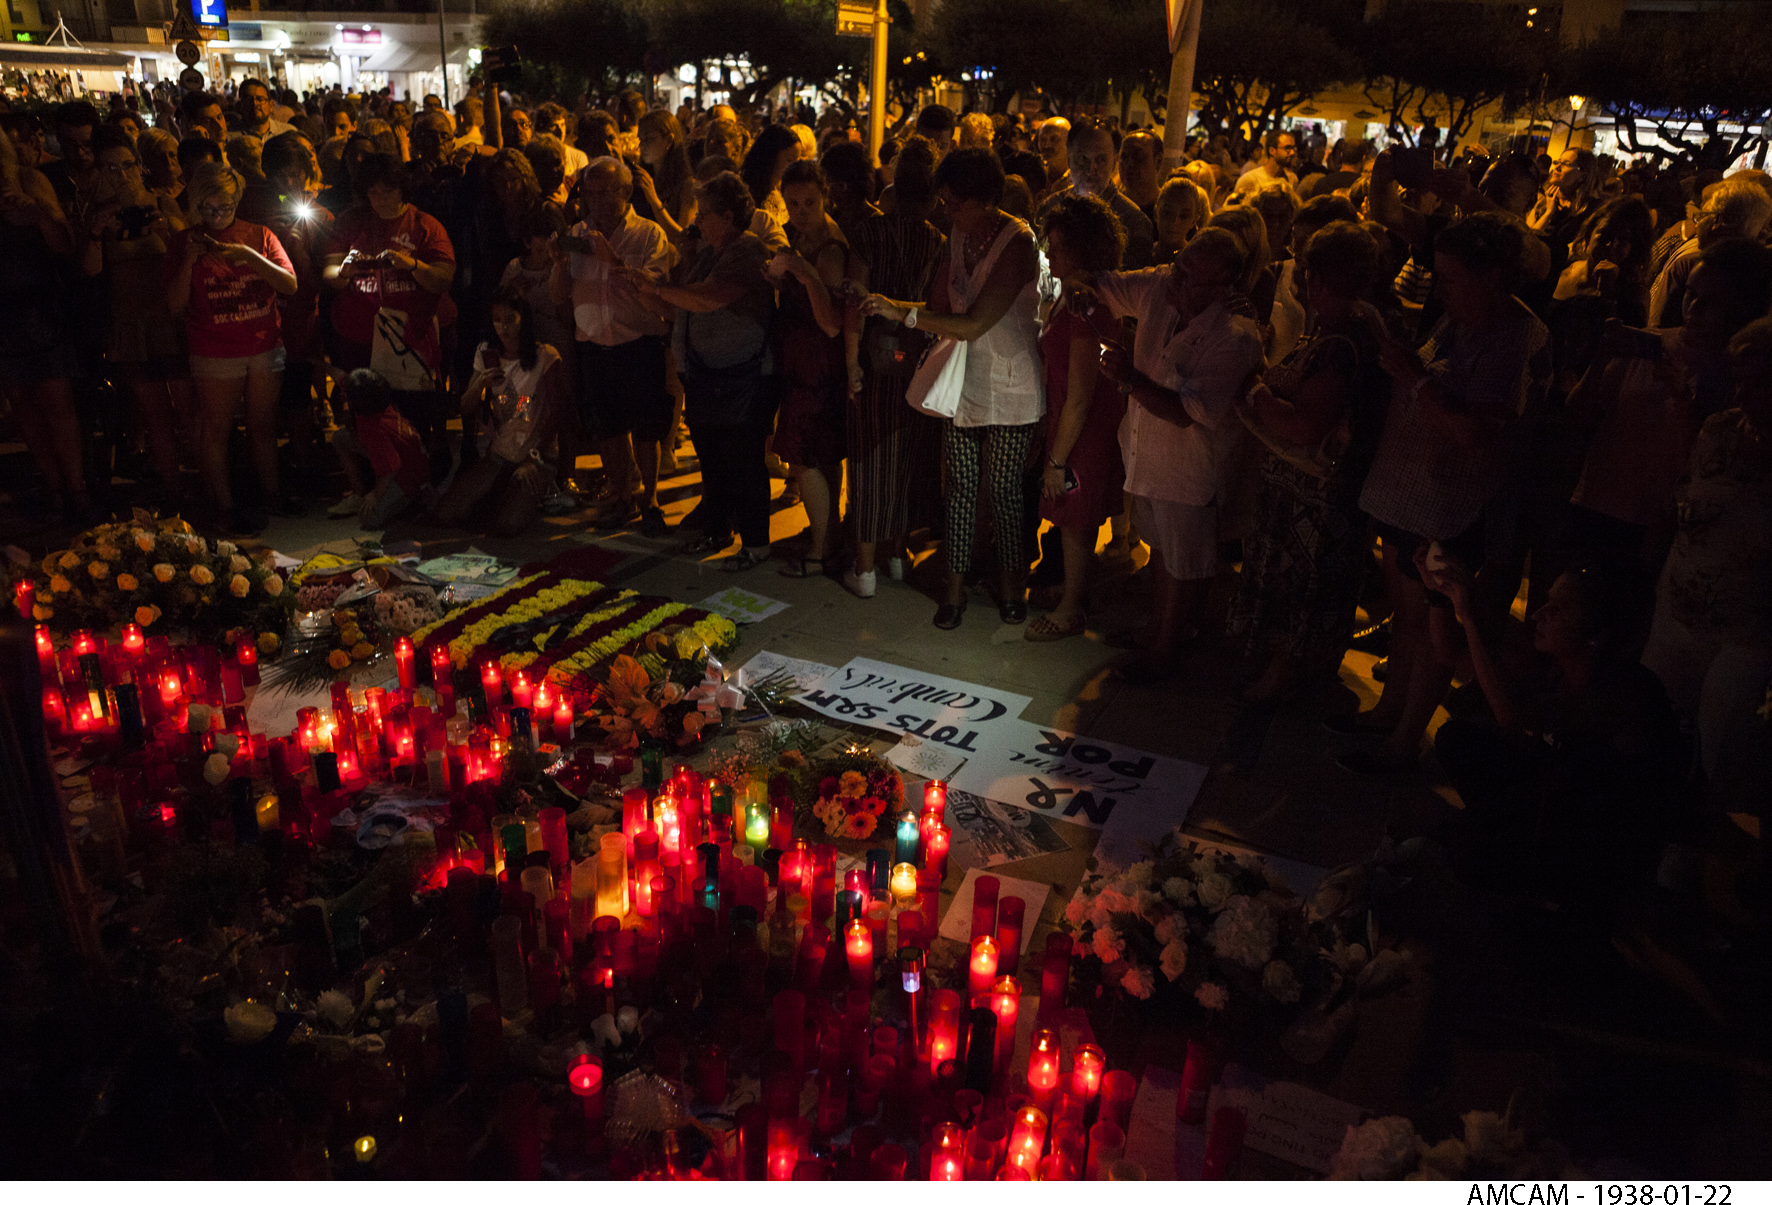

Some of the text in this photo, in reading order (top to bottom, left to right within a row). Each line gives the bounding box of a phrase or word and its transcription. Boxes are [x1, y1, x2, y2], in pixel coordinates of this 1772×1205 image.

[182, 48, 196, 58] 20
[840, 668, 1007, 722] Cambrils
[887, 714, 979, 753] TOTS
[1034, 730, 1156, 779] POR
